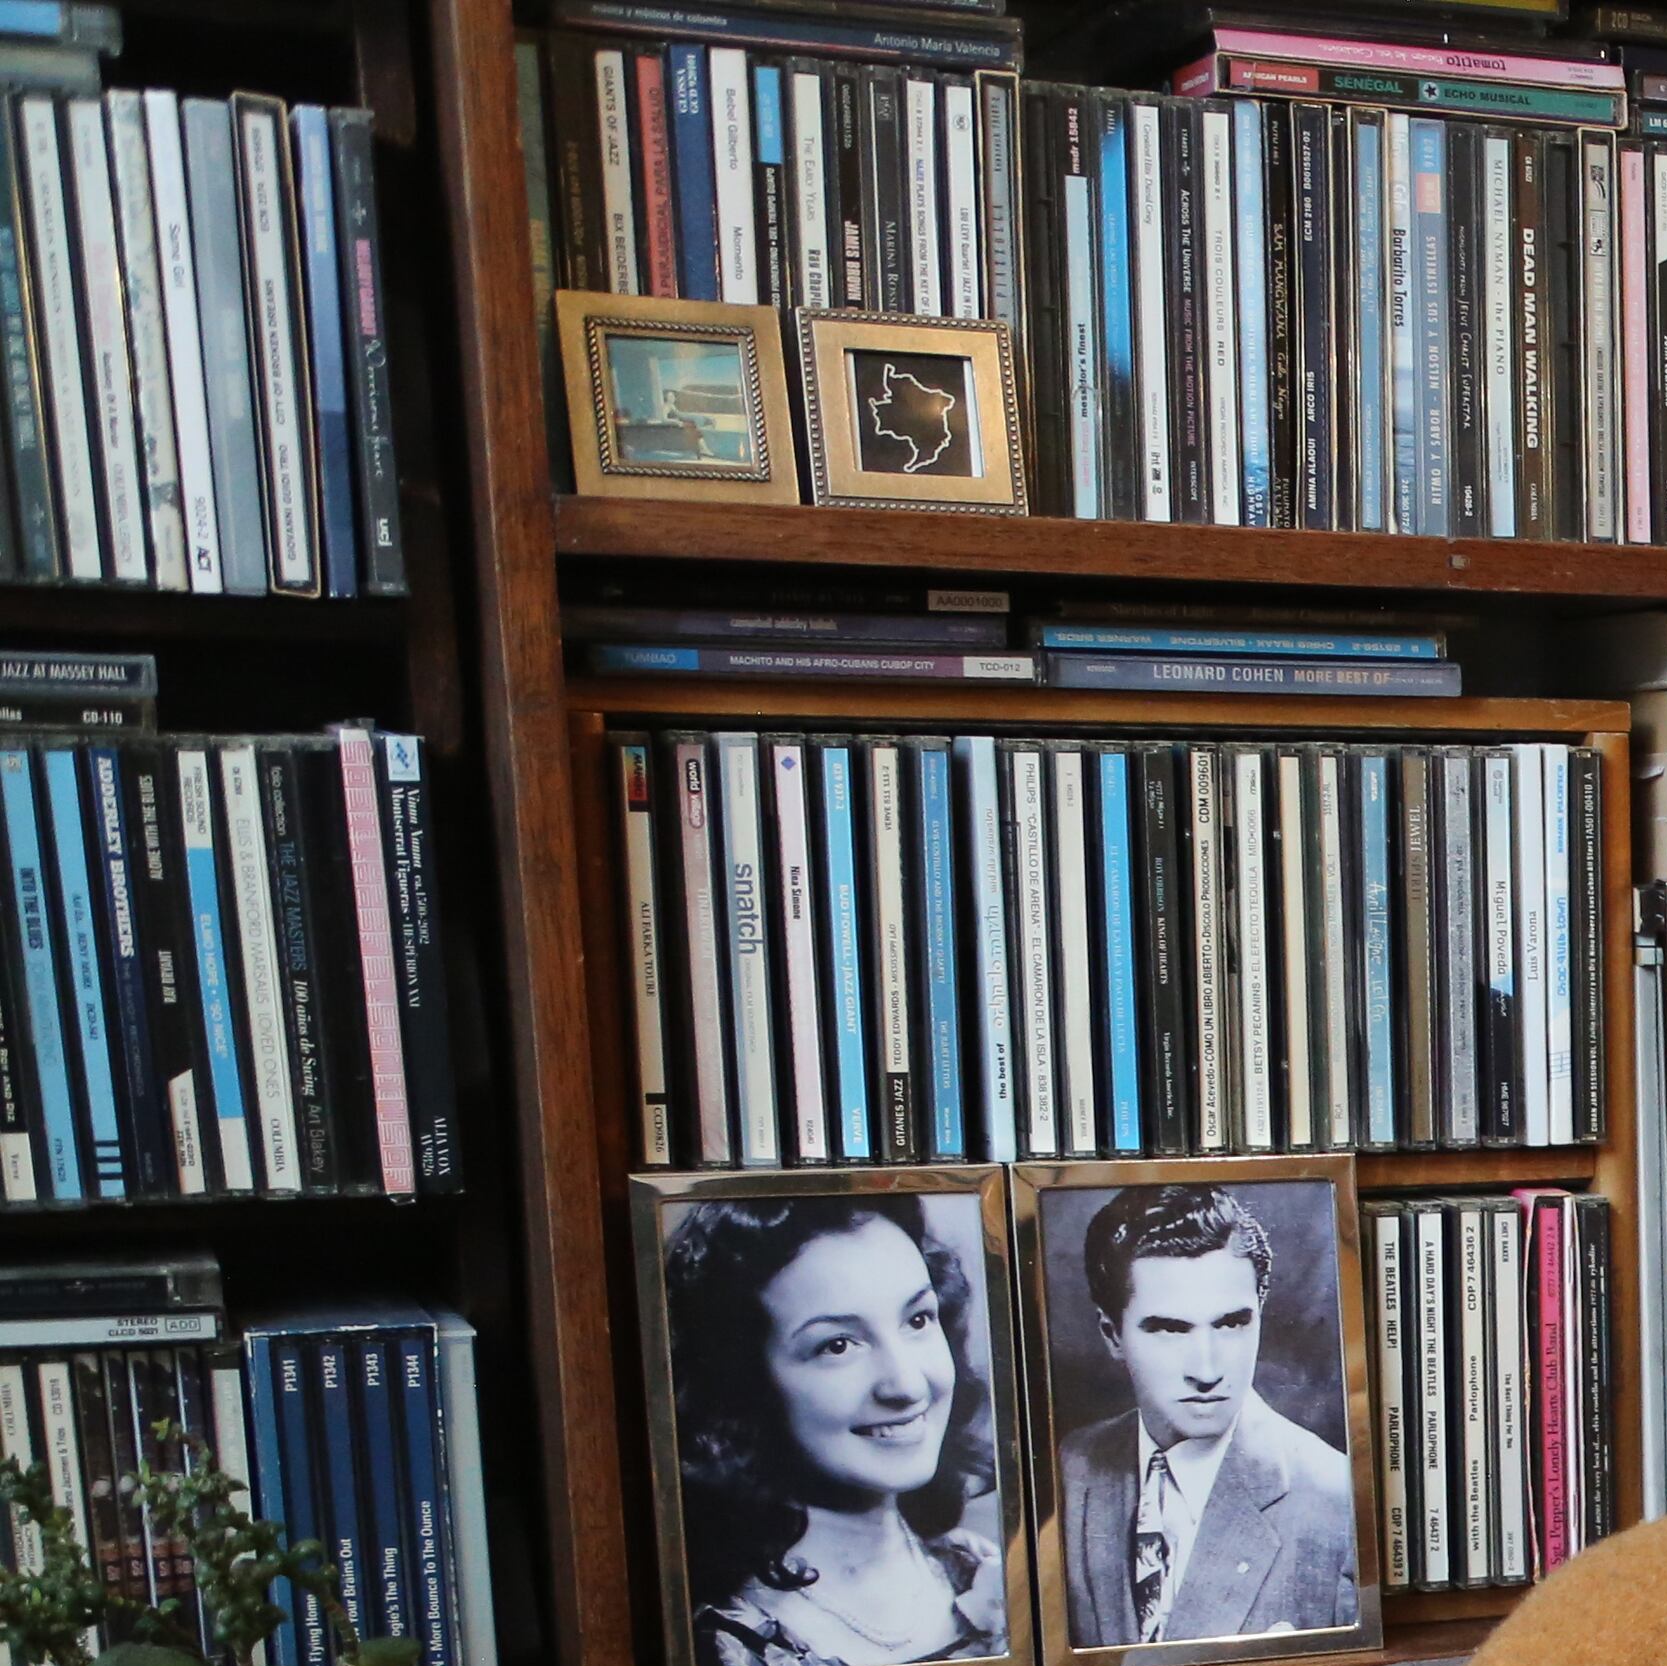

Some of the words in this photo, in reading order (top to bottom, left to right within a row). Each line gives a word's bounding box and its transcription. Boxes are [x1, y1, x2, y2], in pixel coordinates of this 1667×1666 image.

[874, 33, 917, 48] Antonio
[956, 40, 1000, 56] Valencia
[726, 88, 736, 122] Bebel
[1444, 89, 1476, 101] ECHO
[1480, 92, 1532, 105] MUSICAL
[727, 124, 737, 170] Gilberto
[734, 226, 742, 280] Momento
[845, 221, 859, 257] JAMES
[1392, 228, 1406, 286] Barbarito
[1522, 228, 1534, 287] DEAD
[846, 260, 863, 306] BROWN
[1394, 288, 1404, 327] Torres
[1524, 292, 1535, 344] MAN
[1525, 348, 1538, 448] WALKING
[2, 663, 29, 677] JAZZ
[33, 664, 47, 678] AT
[50, 665, 95, 680] MASSEY
[99, 667, 127, 680] HALL
[1153, 664, 1226, 681] LEONARD
[1232, 666, 1284, 682] COHEN
[1295, 670, 1332, 683] MORE
[1336, 671, 1371, 685] BEST
[1374, 671, 1391, 685] OF
[1409, 804, 1421, 852] JEWEL
[98, 757, 122, 856] ADDERLEY
[110, 860, 134, 959] BROTHERS
[790, 866, 800, 888] Nina
[735, 862, 758, 955] snatch
[792, 890, 801, 920] Simone
[1497, 881, 1506, 924] Miguel
[1527, 911, 1537, 950] Varona
[1498, 929, 1506, 975] Poveda
[1527, 953, 1538, 980] Luis
[295, 980, 307, 1003] 100
[302, 1038, 311, 1052] de
[998, 1043, 1004, 1054] of
[302, 1055, 316, 1096] Swing
[895, 1079, 904, 1101] JAZZ
[308, 1104, 319, 1126] Art
[896, 1104, 905, 1146] GITANES
[309, 1129, 325, 1175] Blakey
[1384, 1242, 1395, 1262] THE
[1425, 1249, 1434, 1274] HARD
[1385, 1266, 1396, 1310] BEATLES
[1426, 1276, 1435, 1303] DAY'S
[1387, 1319, 1397, 1348] HELP!
[1427, 1305, 1436, 1334] NIGHT
[1427, 1338, 1436, 1356] THE
[1547, 1323, 1557, 1360] Band
[284, 1360, 297, 1391] P1341
[324, 1355, 338, 1388] P1342
[366, 1353, 380, 1386] P1343
[408, 1355, 420, 1387] P1344
[1427, 1359, 1437, 1397] BEATLES
[1548, 1361, 1558, 1391] Club
[1470, 1355, 1479, 1421] Parlophone
[1548, 1394, 1558, 1437] Hearts
[1389, 1407, 1400, 1472] PARLOPHONE
[1471, 1459, 1479, 1500] Beatles
[1548, 1438, 1562, 1487] Lonely
[421, 1501, 432, 1535] Ounce
[1471, 1504, 1479, 1524] the
[1549, 1489, 1563, 1540] Pepper's
[424, 1540, 435, 1558] The
[1472, 1528, 1480, 1550] with
[1550, 1543, 1562, 1566] Sgt.
[425, 1560, 436, 1573] To
[427, 1577, 441, 1622] Bounce
[431, 1624, 443, 1651] More
